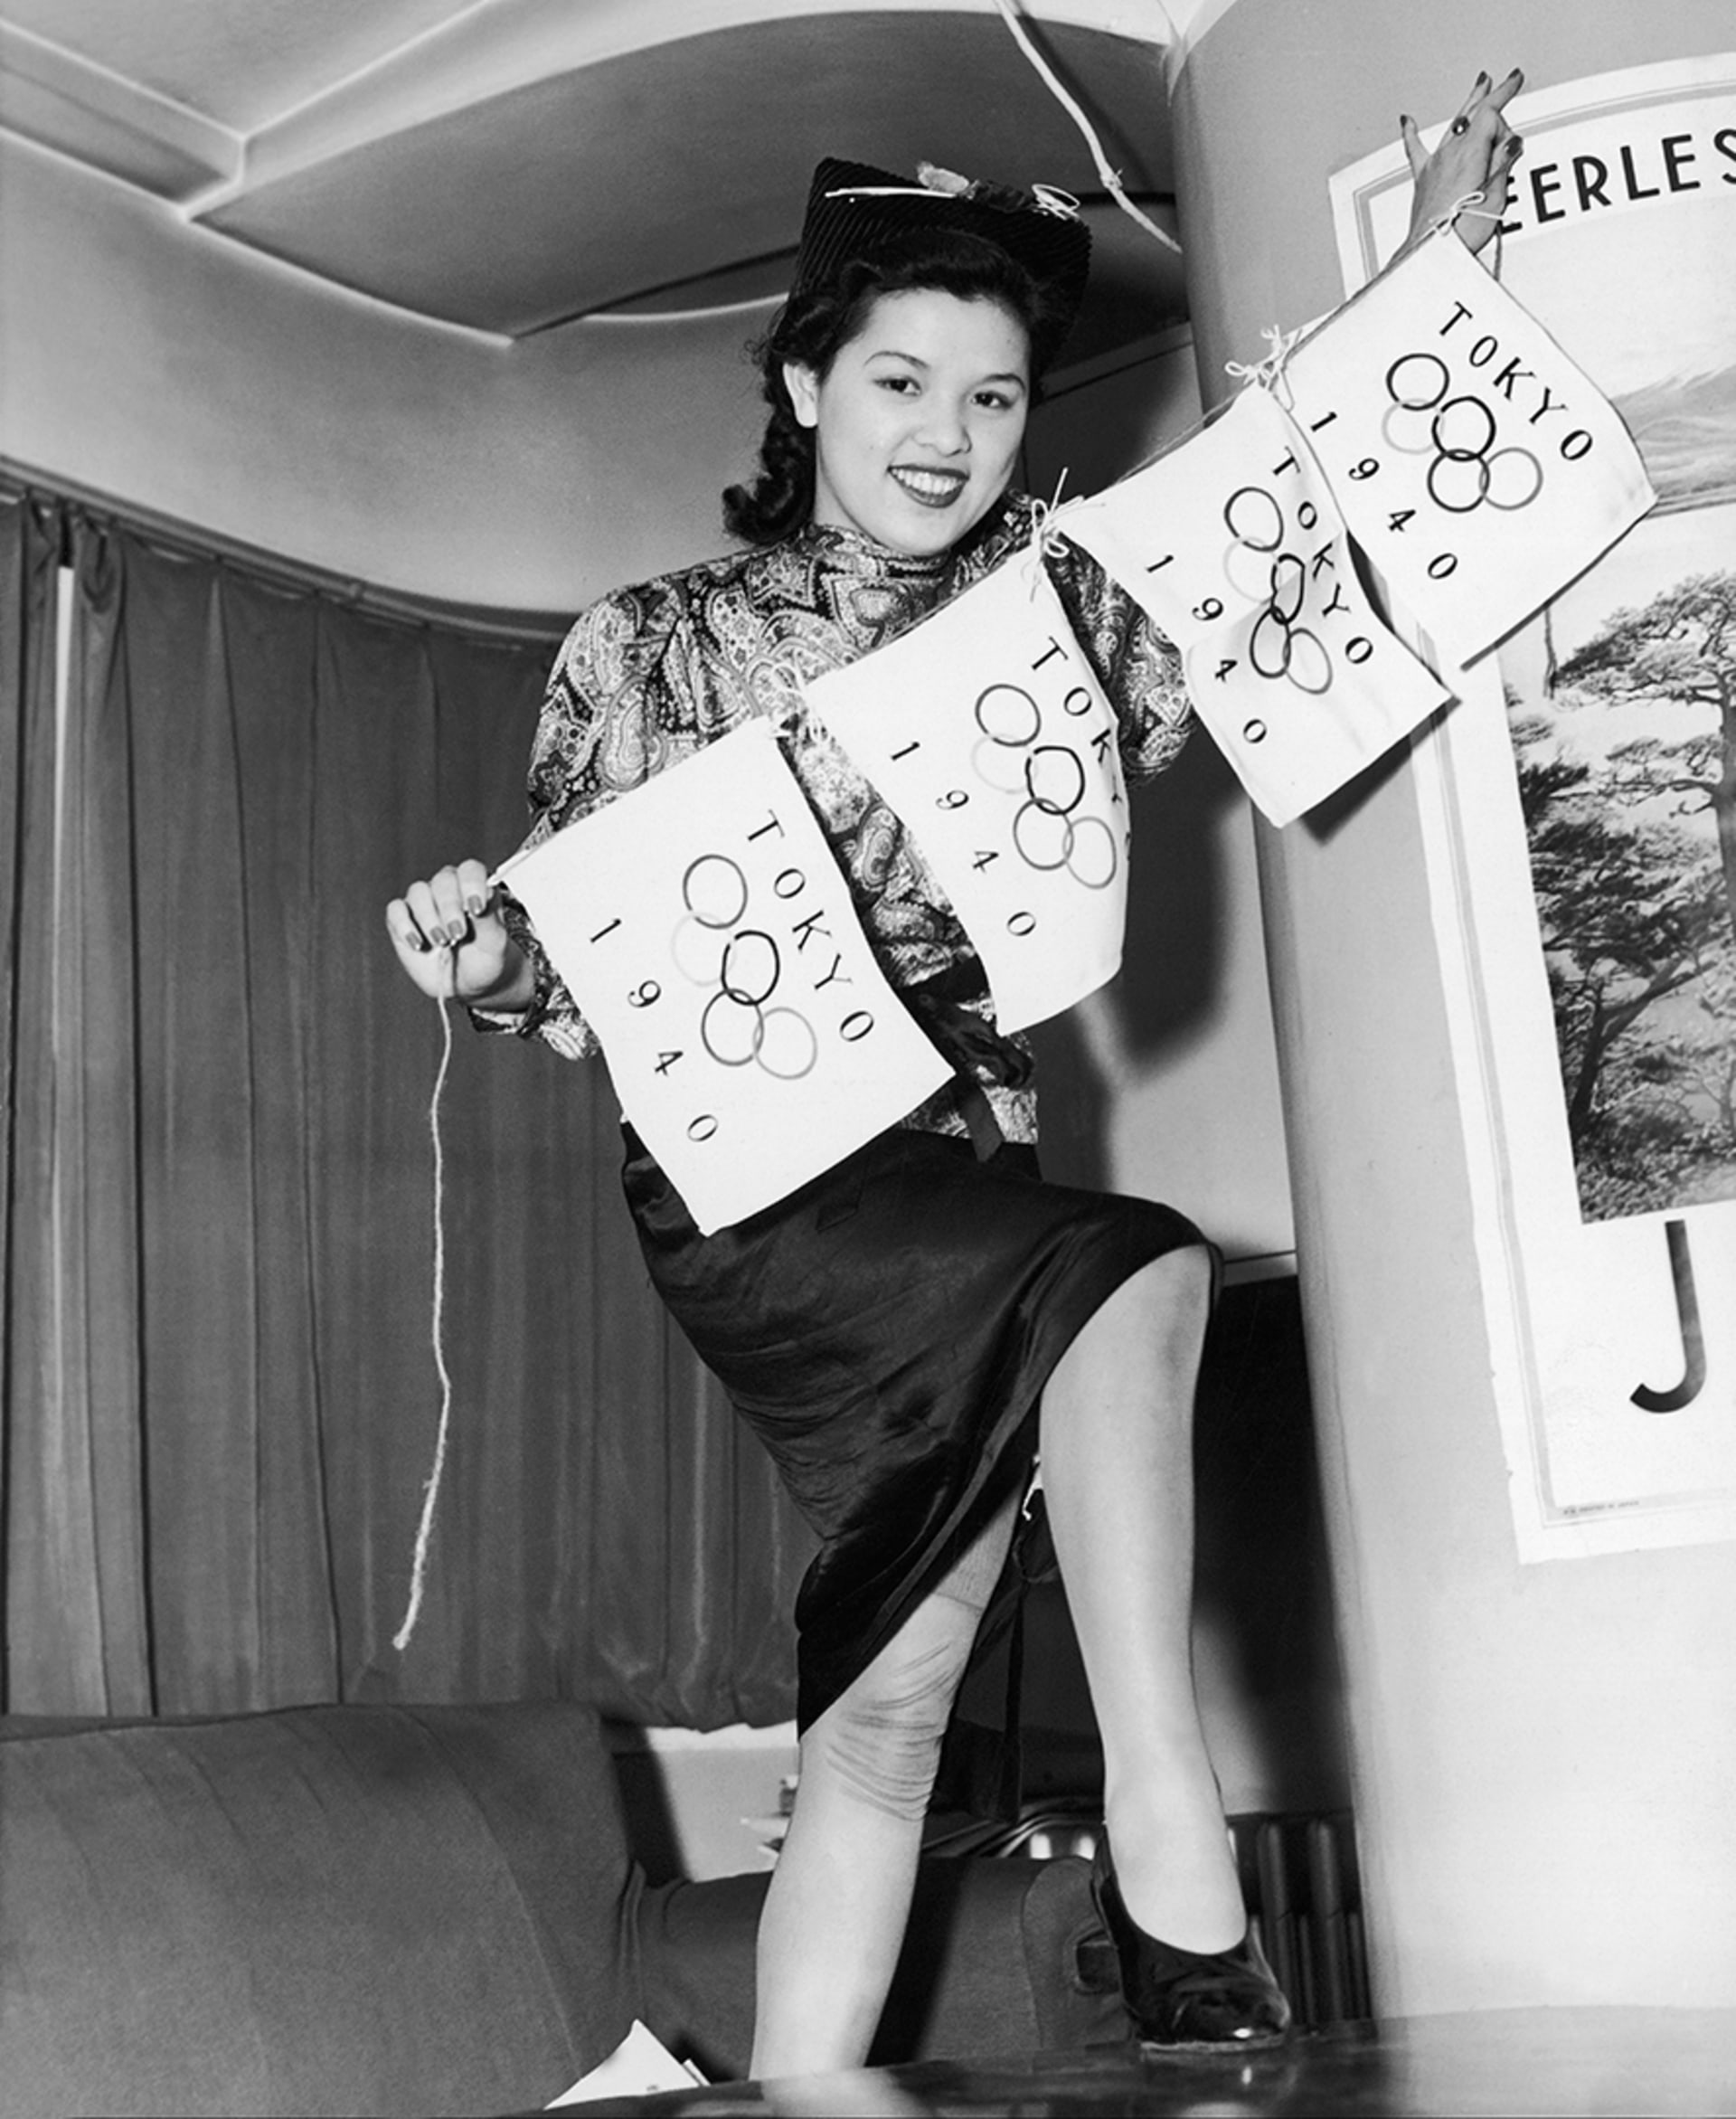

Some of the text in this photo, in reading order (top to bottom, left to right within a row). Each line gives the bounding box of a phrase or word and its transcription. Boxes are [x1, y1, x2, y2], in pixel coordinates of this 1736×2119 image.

[1438, 301, 1593, 461] TOKYO
[1272, 446, 1373, 664] TOKYO
[1310, 411, 1459, 580] 1940
[1146, 554, 1267, 743] 1940
[747, 809, 874, 1042] TOKYO
[891, 741, 1036, 937] 1940
[590, 918, 719, 1142] 1940
